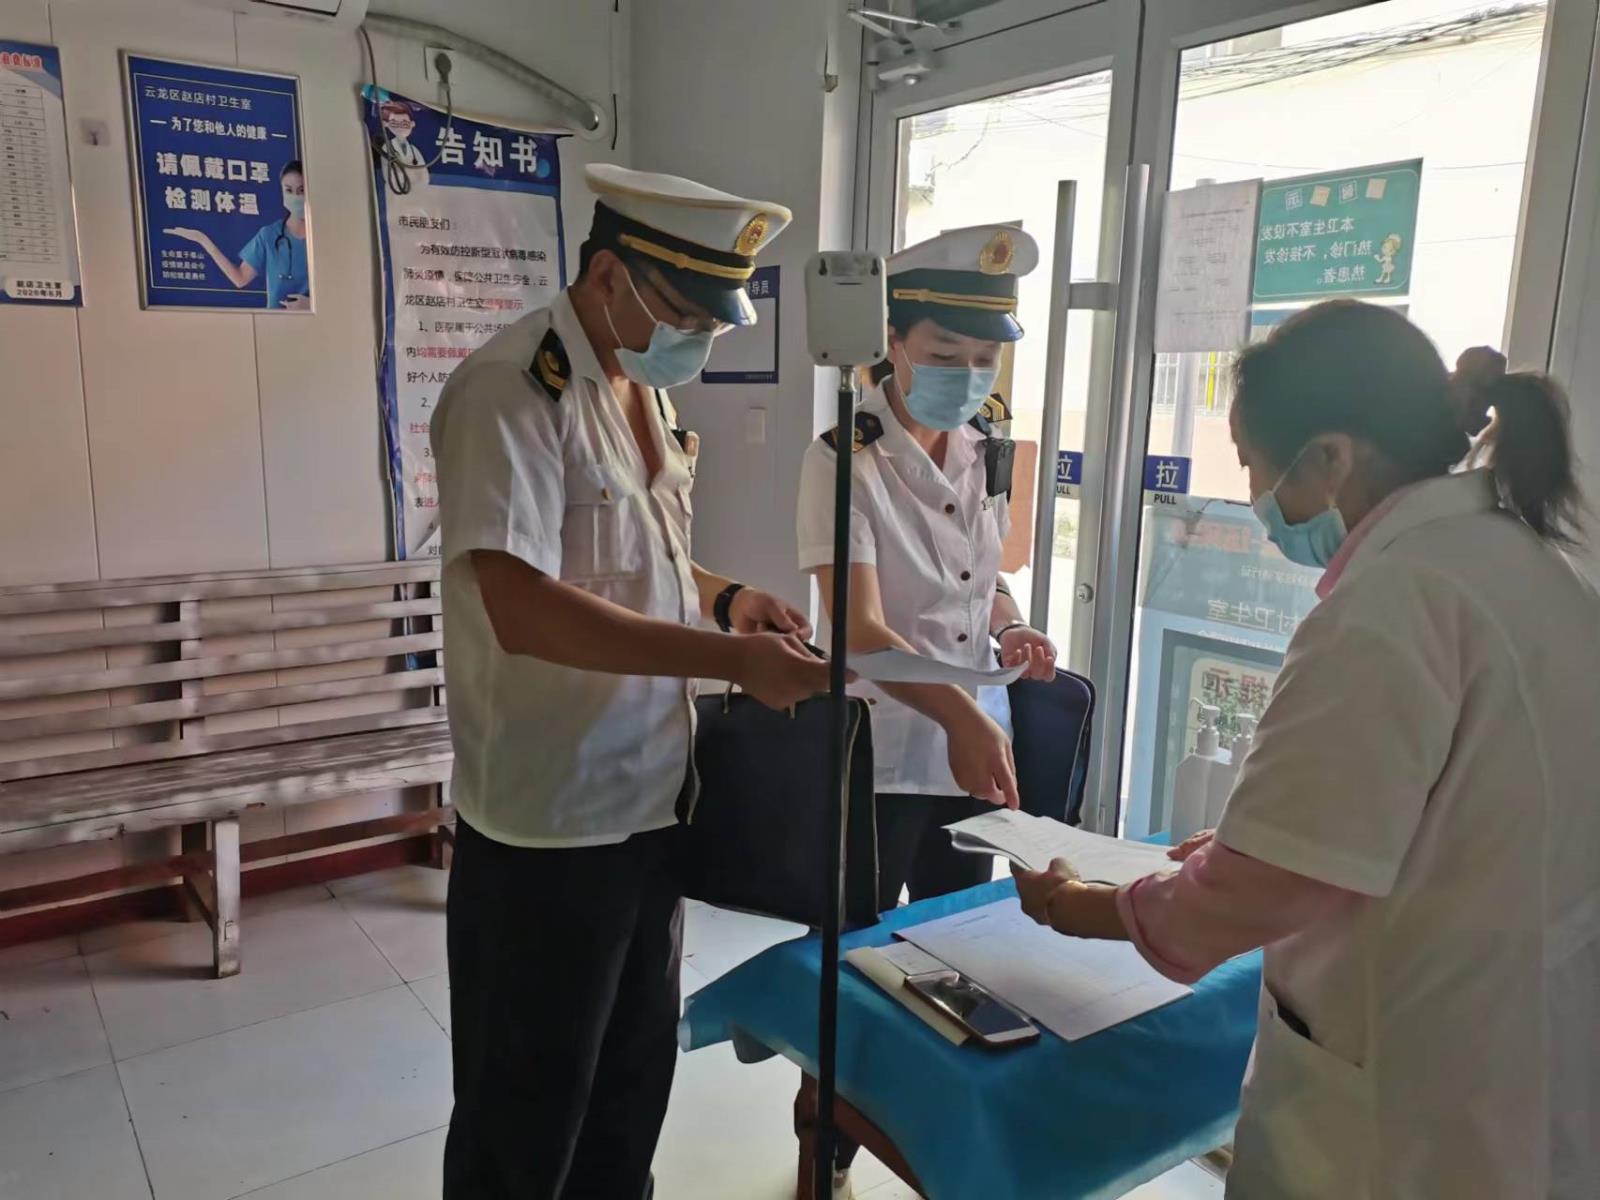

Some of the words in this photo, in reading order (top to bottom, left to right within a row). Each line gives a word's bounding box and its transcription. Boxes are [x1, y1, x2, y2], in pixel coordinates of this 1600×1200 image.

[144, 86, 252, 110] 云龙区赵店村卫生室
[171, 116, 267, 140] 为了您和他人的健康
[435, 126, 538, 173] 告知书
[156, 152, 270, 183] 请佩戴口罩
[165, 186, 259, 215] 检测体温
[1155, 460, 1179, 488] 拉
[1056, 486, 1071, 495] ULL
[1154, 493, 1177, 505] PULL
